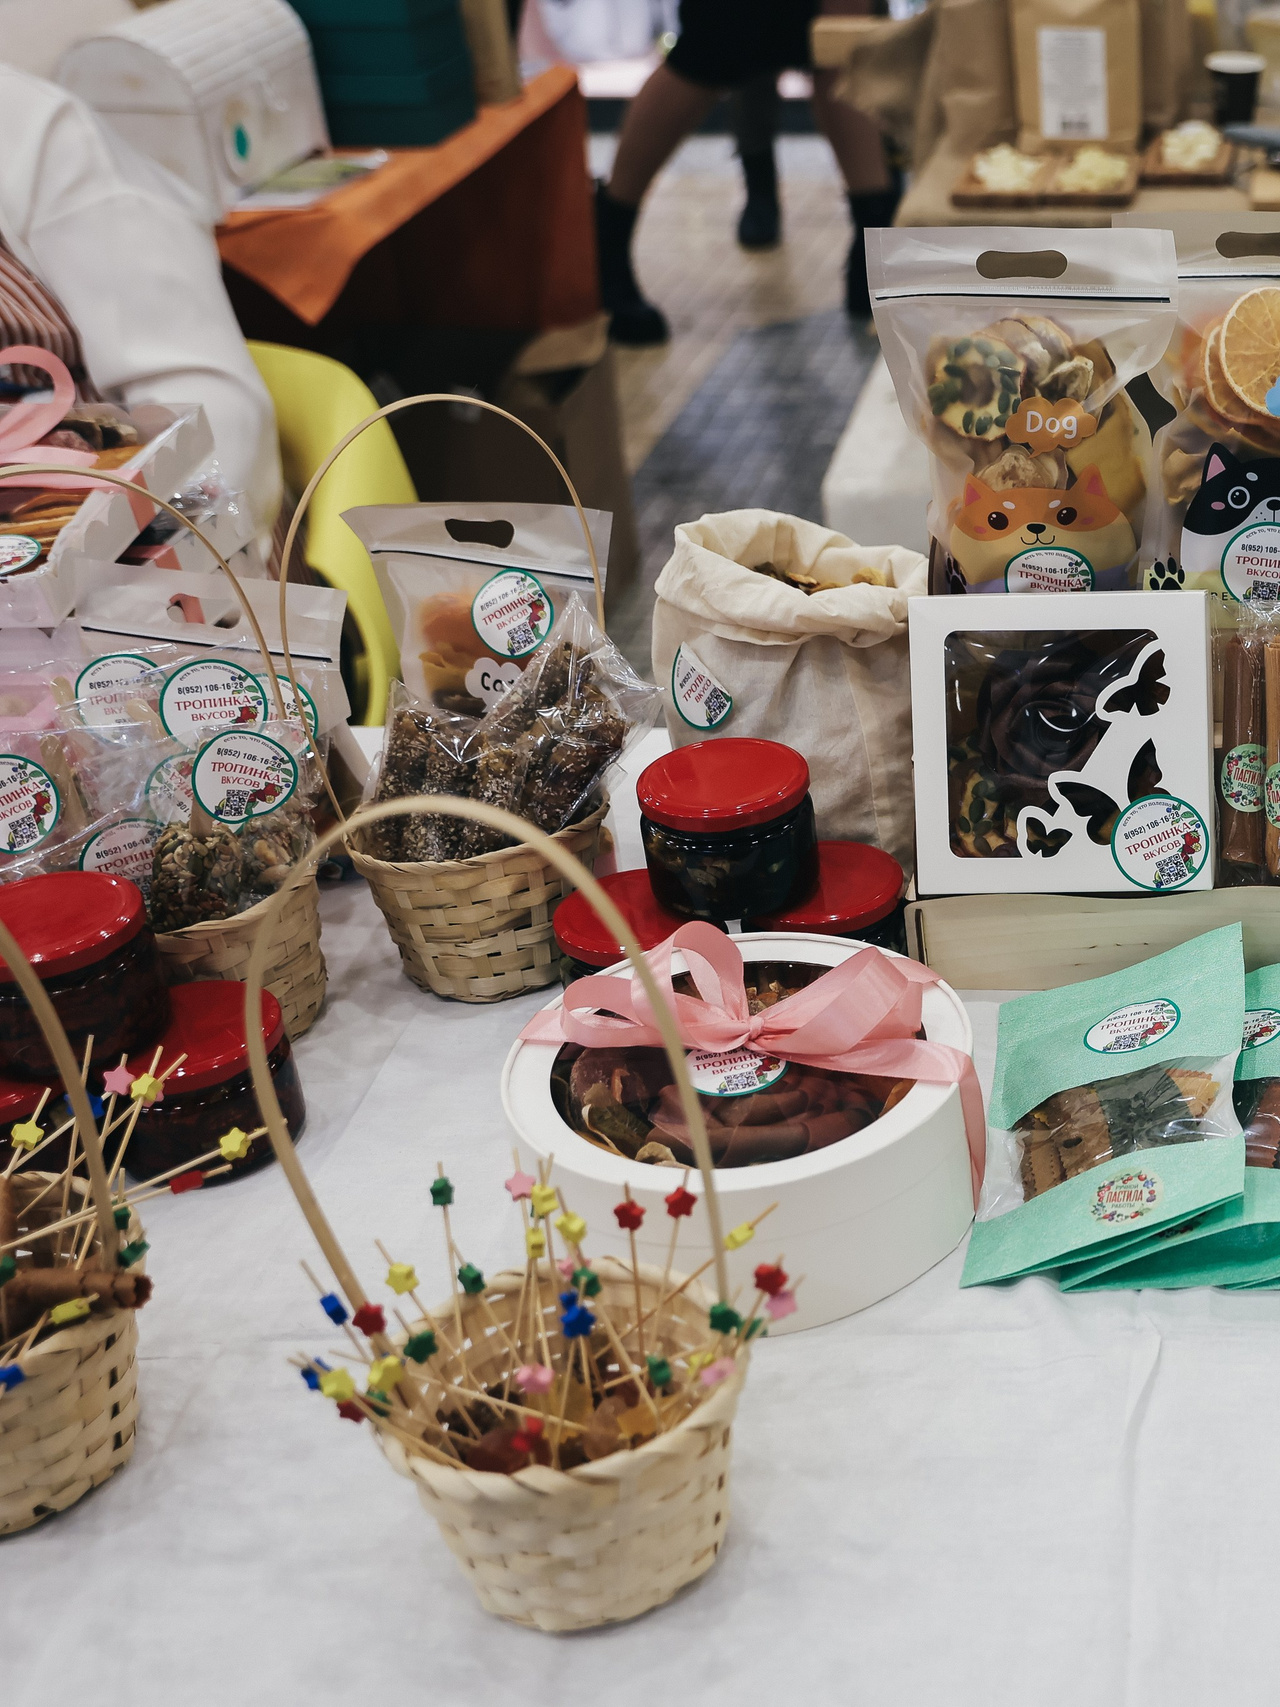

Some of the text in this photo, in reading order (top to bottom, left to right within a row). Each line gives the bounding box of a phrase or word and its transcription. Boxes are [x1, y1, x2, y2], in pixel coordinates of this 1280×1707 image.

[1026, 410, 1078, 440] Dog
[1017, 570, 1083, 587] ТРОПИНКА
[482, 592, 535, 626] ТРОПИНКА
[496, 608, 529, 630] ВКУСОВ
[179, 671, 191, 681] есть
[694, 679, 712, 703] ВКУСО
[104, 707, 123, 716] ВКУ
[174, 695, 252, 712] ТРОПИНКА
[191, 710, 236, 722] ВКУСОВ
[223, 735, 237, 743] есть
[249, 736, 261, 744] что
[211, 762, 281, 783] ТРОПИНКА
[221, 776, 260, 788] ВКУСОВ
[0, 782, 41, 806] ПИНКА
[1122, 814, 1131, 827] есть
[1130, 809, 1139, 817] то,
[1123, 826, 1146, 840] 8(952)
[1125, 822, 1191, 856] ТРОПИНКА
[1142, 839, 1182, 861] ВКУСОВ
[95, 849, 155, 872] ТРОПИН
[1100, 1015, 1166, 1031] ТРОПИНКА
[1109, 1024, 1149, 1035] ВКУСОВ
[693, 1053, 766, 1071] ТРОПИНК
[712, 1061, 758, 1075] ВКУСОВ
[1106, 1189, 1143, 1203] ПАСТИЛА
